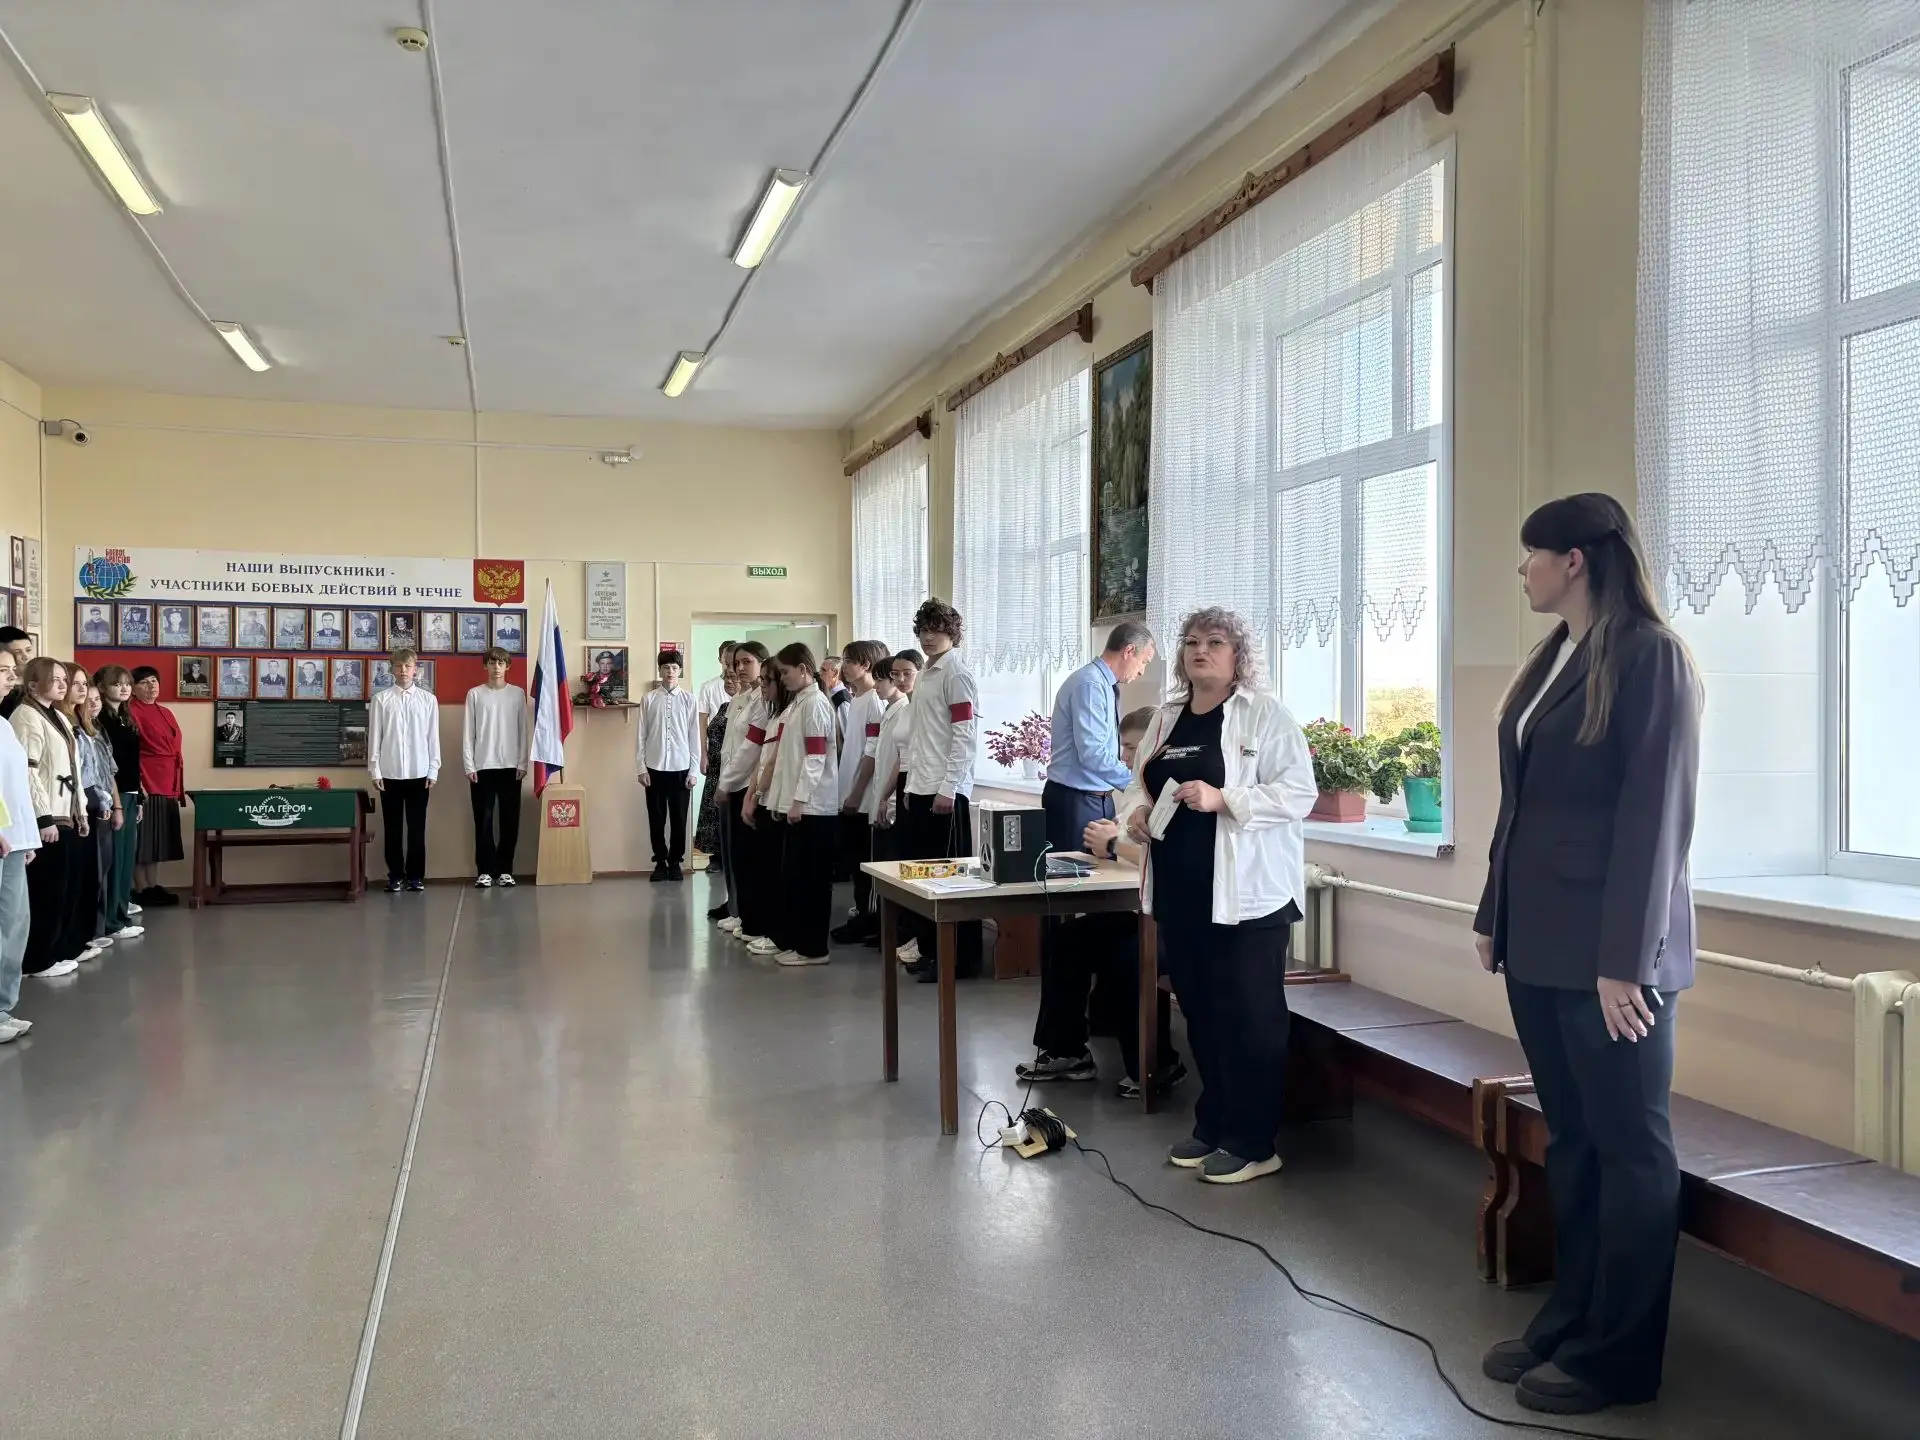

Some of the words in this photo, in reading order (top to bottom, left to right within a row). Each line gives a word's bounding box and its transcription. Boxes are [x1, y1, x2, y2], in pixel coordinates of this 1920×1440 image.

[226, 562, 273, 574] НАШИ
[279, 564, 385, 577] ВЫПУСКНИКИ
[752, 567, 784, 576] ВЫХОД
[150, 579, 245, 592] УЧАСТНИКИ
[251, 582, 314, 594] БОЕВЫХ
[318, 583, 397, 596] ДЕЙСТВИЙ
[403, 587, 411, 596] В
[416, 587, 462, 598] ЧЕЧНЕ
[244, 805, 275, 814] ПАРТА
[277, 804, 306, 813] ГЕРОЯ
